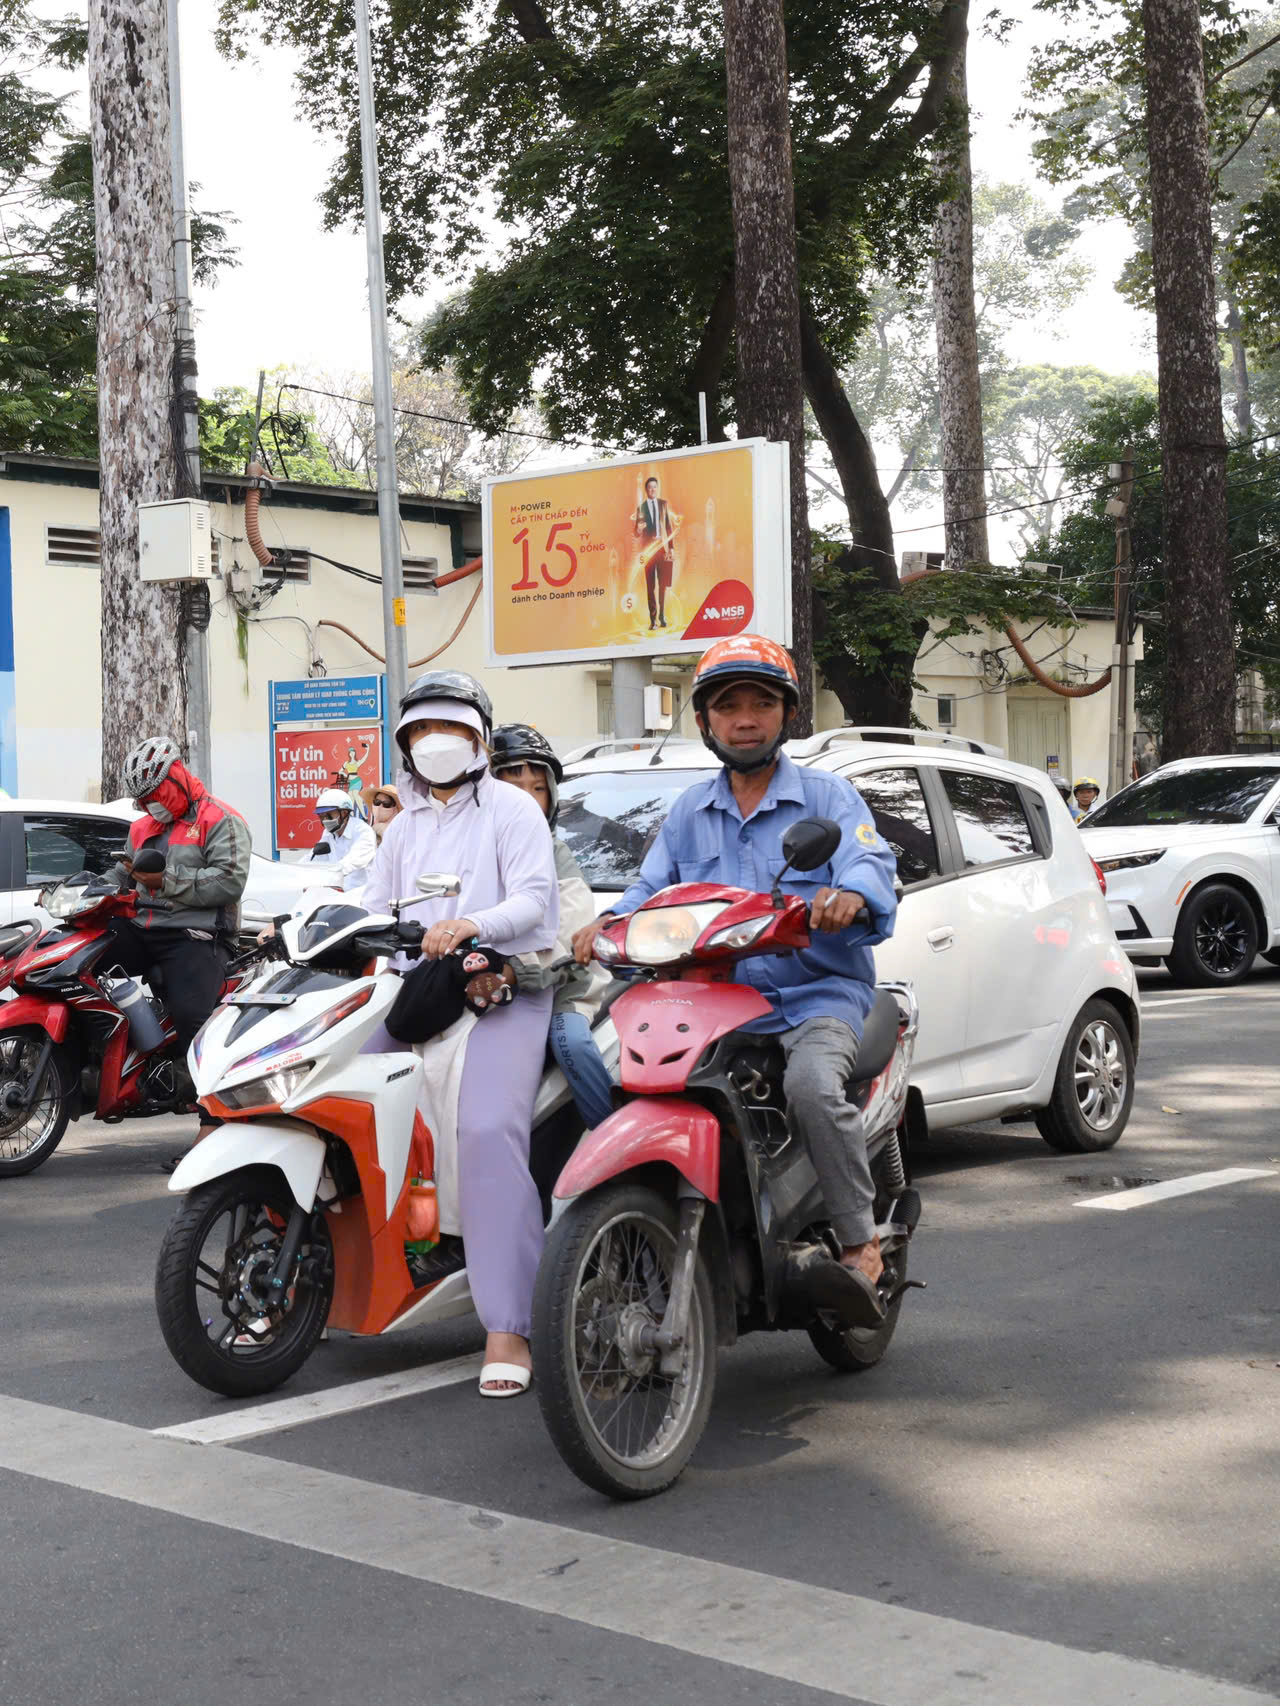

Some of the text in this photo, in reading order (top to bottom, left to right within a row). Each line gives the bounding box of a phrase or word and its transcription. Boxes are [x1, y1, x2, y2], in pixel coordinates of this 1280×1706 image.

[511, 522, 578, 591] 15
[511, 587, 605, 604] dành cho Doanh nghiệp
[721, 605, 745, 618] MSB
[279, 745, 324, 766] Tự tin
[280, 764, 328, 781] cá tính
[280, 784, 297, 799] tôi
